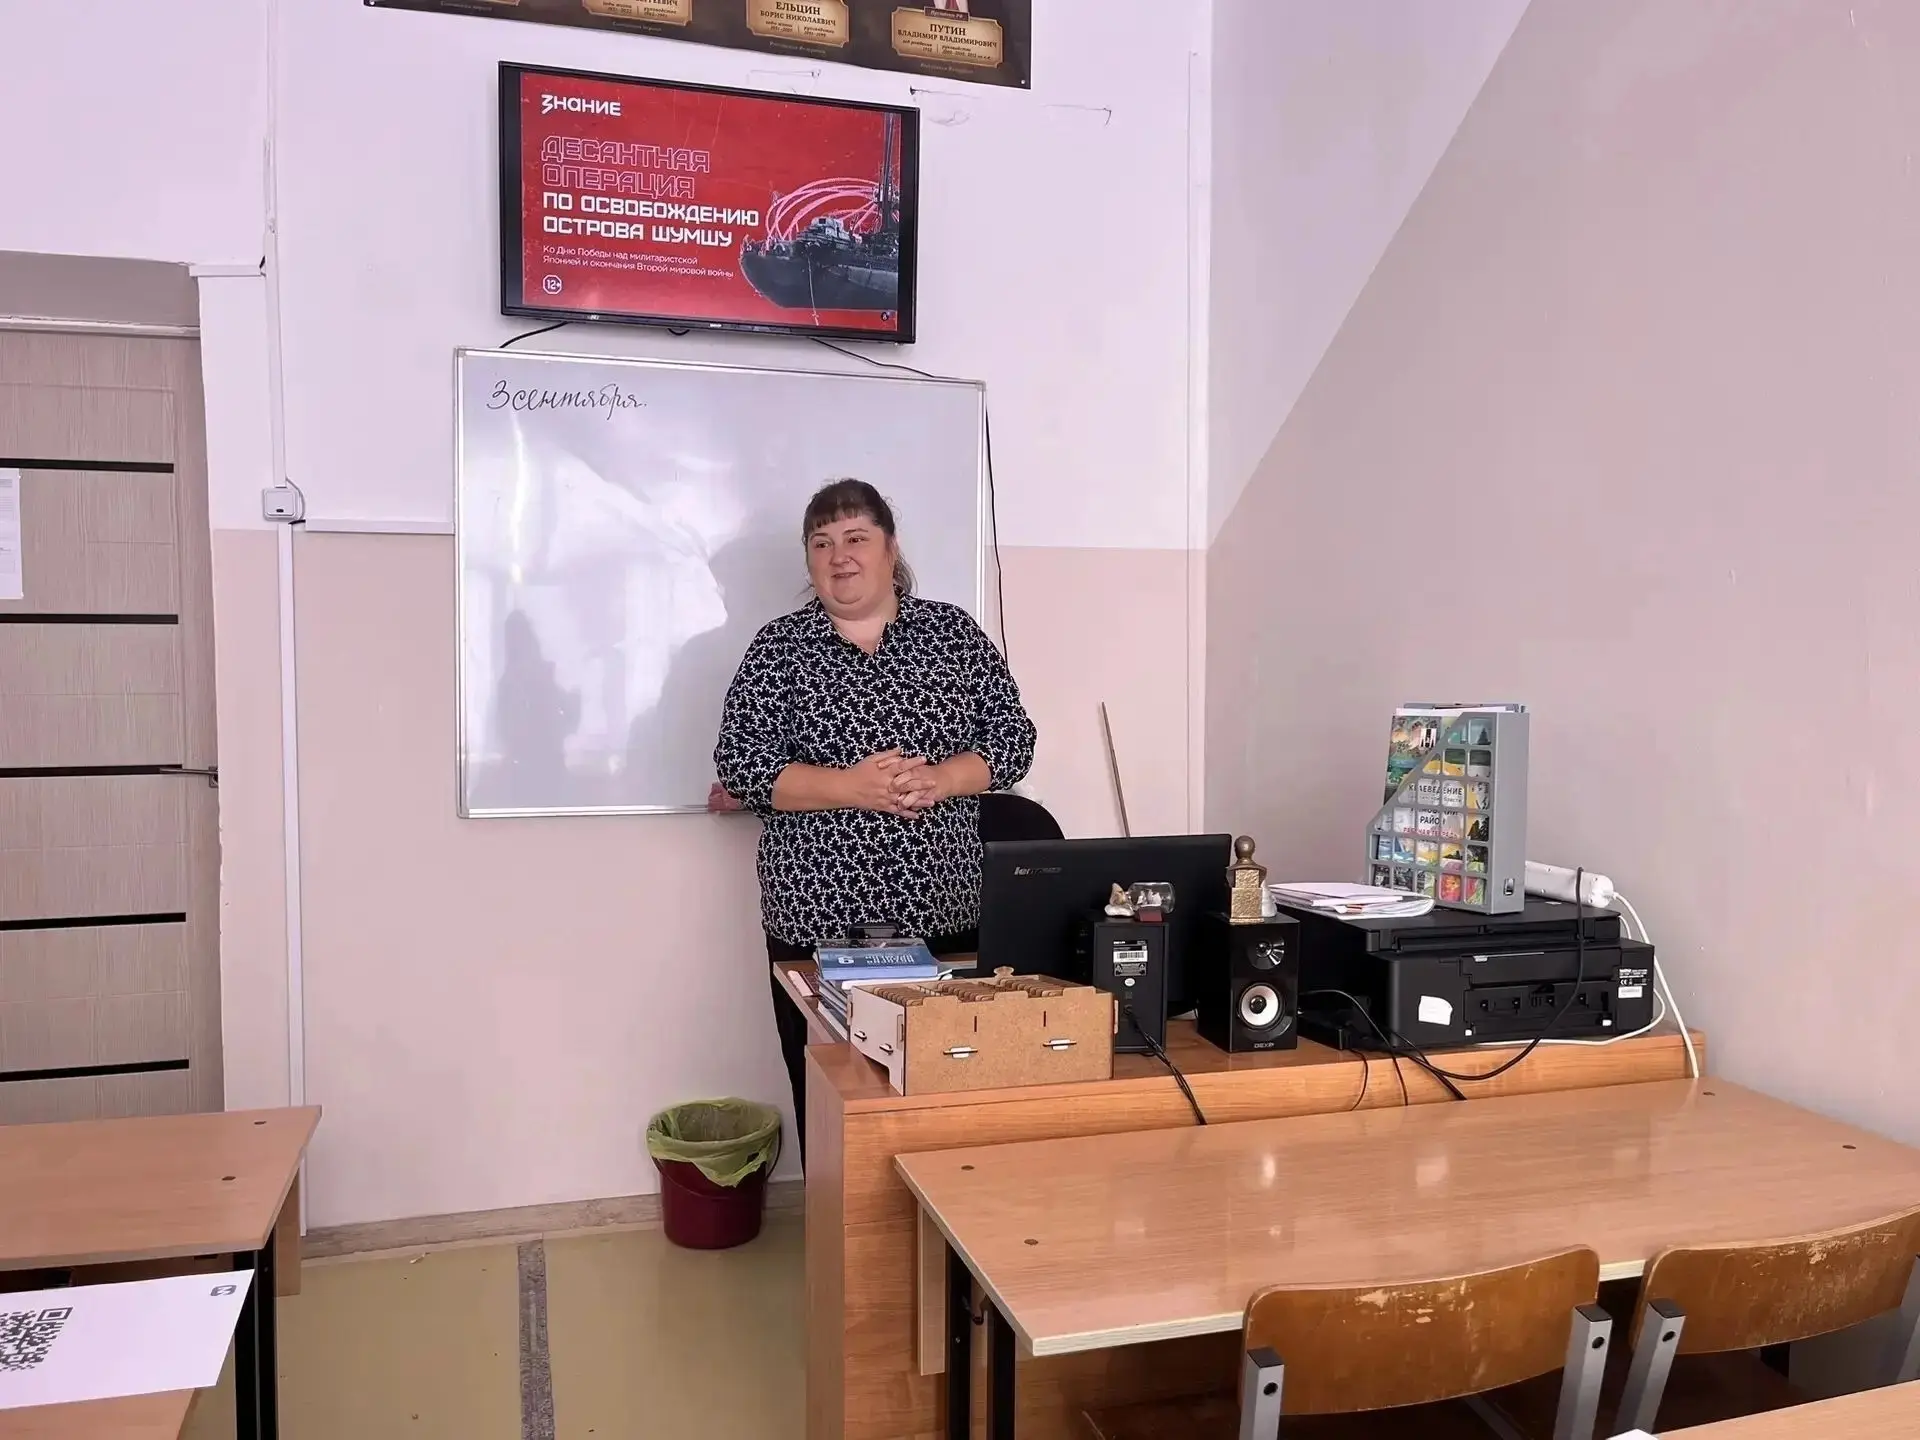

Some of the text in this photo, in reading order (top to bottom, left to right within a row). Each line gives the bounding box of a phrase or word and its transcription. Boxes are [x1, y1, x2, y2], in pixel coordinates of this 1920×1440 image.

[760, 10, 836, 26] БОРИС НИКОЛАЕВИЧ
[776, 1, 821, 15] ЕЛЬЦИН
[897, 29, 998, 48] ВЛАДИМИР ВЛАДИМИРОВИЧ
[929, 23, 967, 36] ПУТИН
[541, 135, 710, 173] ДЕСАНТНАЯ
[542, 164, 695, 199] ОПЕРАЦИЯ
[543, 192, 759, 227] ПО ОСВОБОЖДЕНИЮ
[543, 216, 733, 247] ОСТРОВА ШУМШУ
[543, 245, 698, 265] Ко Дню Победы над милитаристской
[543, 256, 581, 266] Японией
[589, 260, 635, 270] окончания
[637, 262, 668, 274] Второй
[669, 265, 706, 277] мировой
[707, 267, 734, 278] войны
[546, 279, 561, 290] 12+
